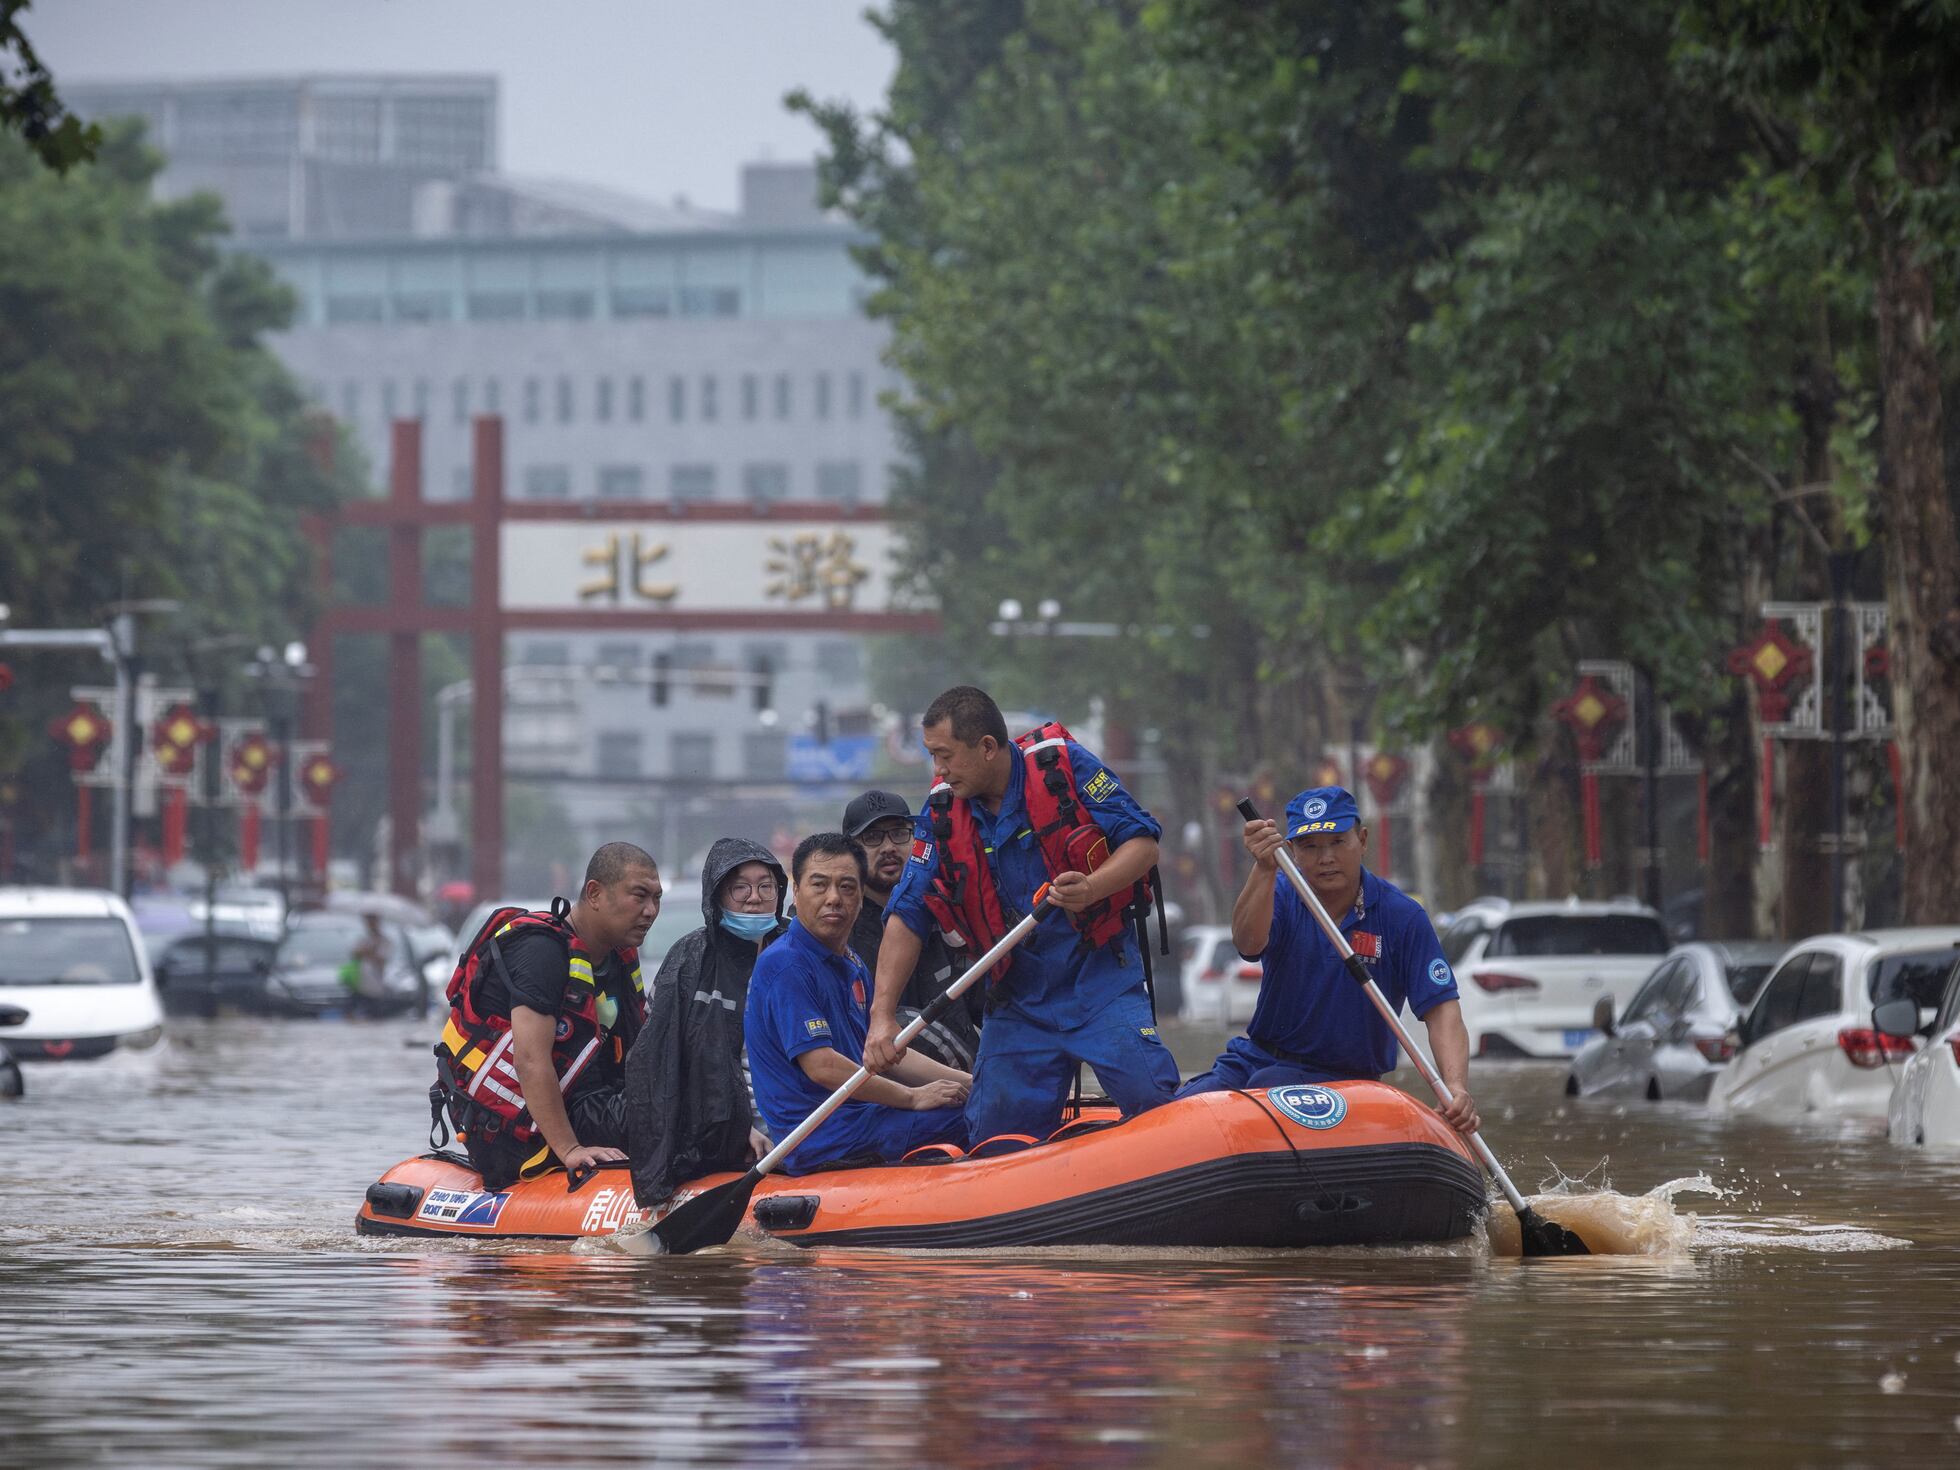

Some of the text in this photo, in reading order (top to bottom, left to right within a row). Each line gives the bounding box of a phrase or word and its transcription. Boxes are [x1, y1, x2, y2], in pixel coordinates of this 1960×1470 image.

[1088, 771, 1108, 796] BSR
[1296, 821, 1337, 835] BSR
[808, 1019, 828, 1031] BSR
[1140, 1027, 1156, 1036] BSR
[1286, 1093, 1330, 1106] BSR
[429, 1190, 451, 1202] ZHAO
[422, 1203, 443, 1216] BOAT
